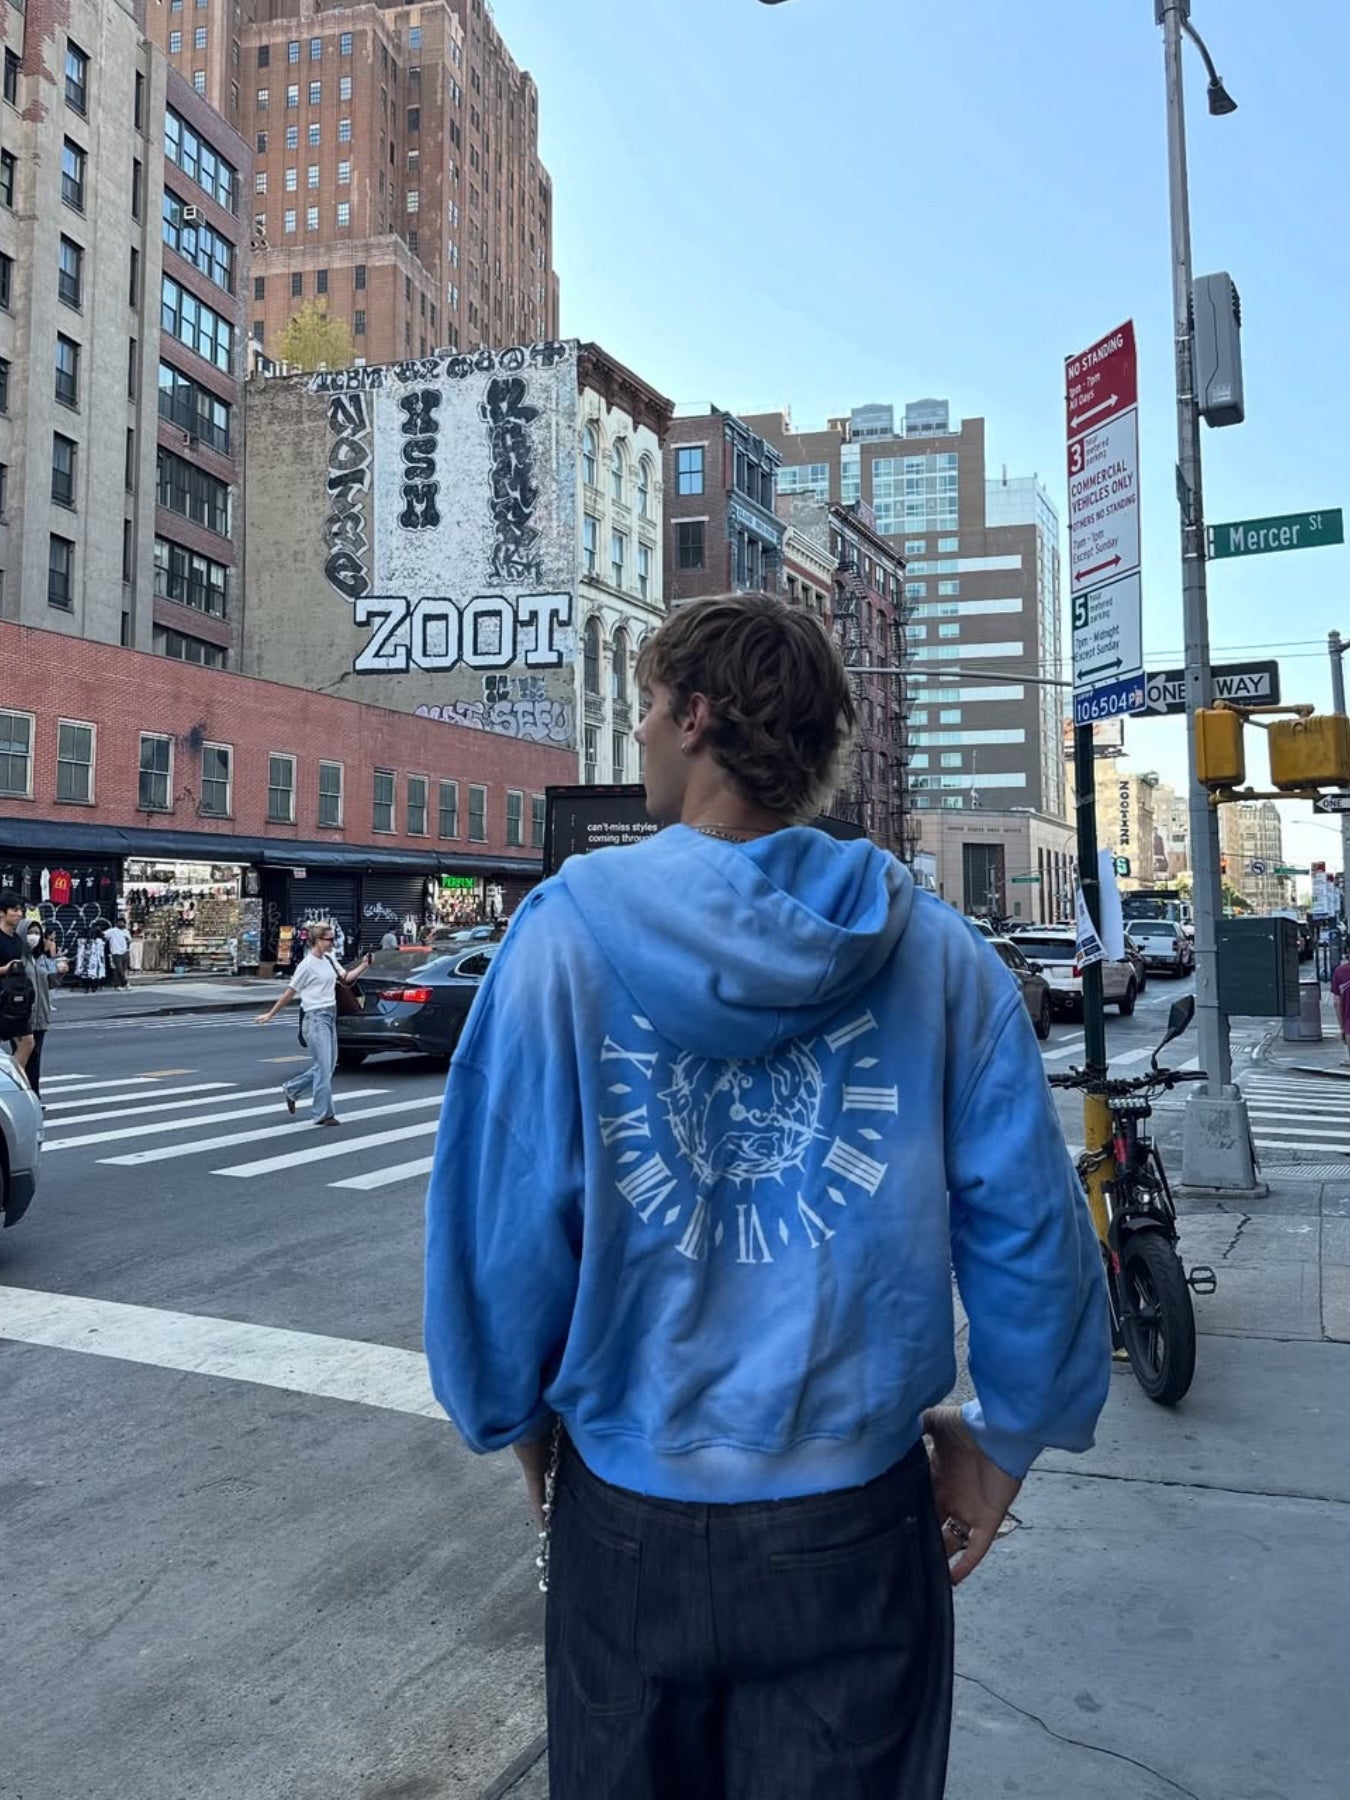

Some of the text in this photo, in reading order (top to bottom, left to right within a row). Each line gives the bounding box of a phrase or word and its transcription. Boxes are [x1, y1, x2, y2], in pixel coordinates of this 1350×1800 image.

[1068, 333, 1123, 380] NO STANDING
[1071, 443, 1082, 472] 3
[1071, 459, 1127, 497] COMMERCIAL
[1072, 471, 1133, 514] VEHICLES ONLY
[1072, 493, 1136, 532] OTHERS NO STANDING
[1229, 514, 1322, 552] Mercer St
[1073, 536, 1118, 564] Except Sunday
[1075, 597, 1086, 627] 5
[353, 592, 573, 674] ZOOT
[1094, 625, 1120, 641] Midnight
[1075, 641, 1119, 662] Except Sunday
[1148, 675, 1264, 702] ONE WAY
[1323, 798, 1343, 809] ONE
[587, 822, 657, 833] can't-miss styles
[588, 834, 619, 844] coming
[842, 1084, 898, 1114] III
